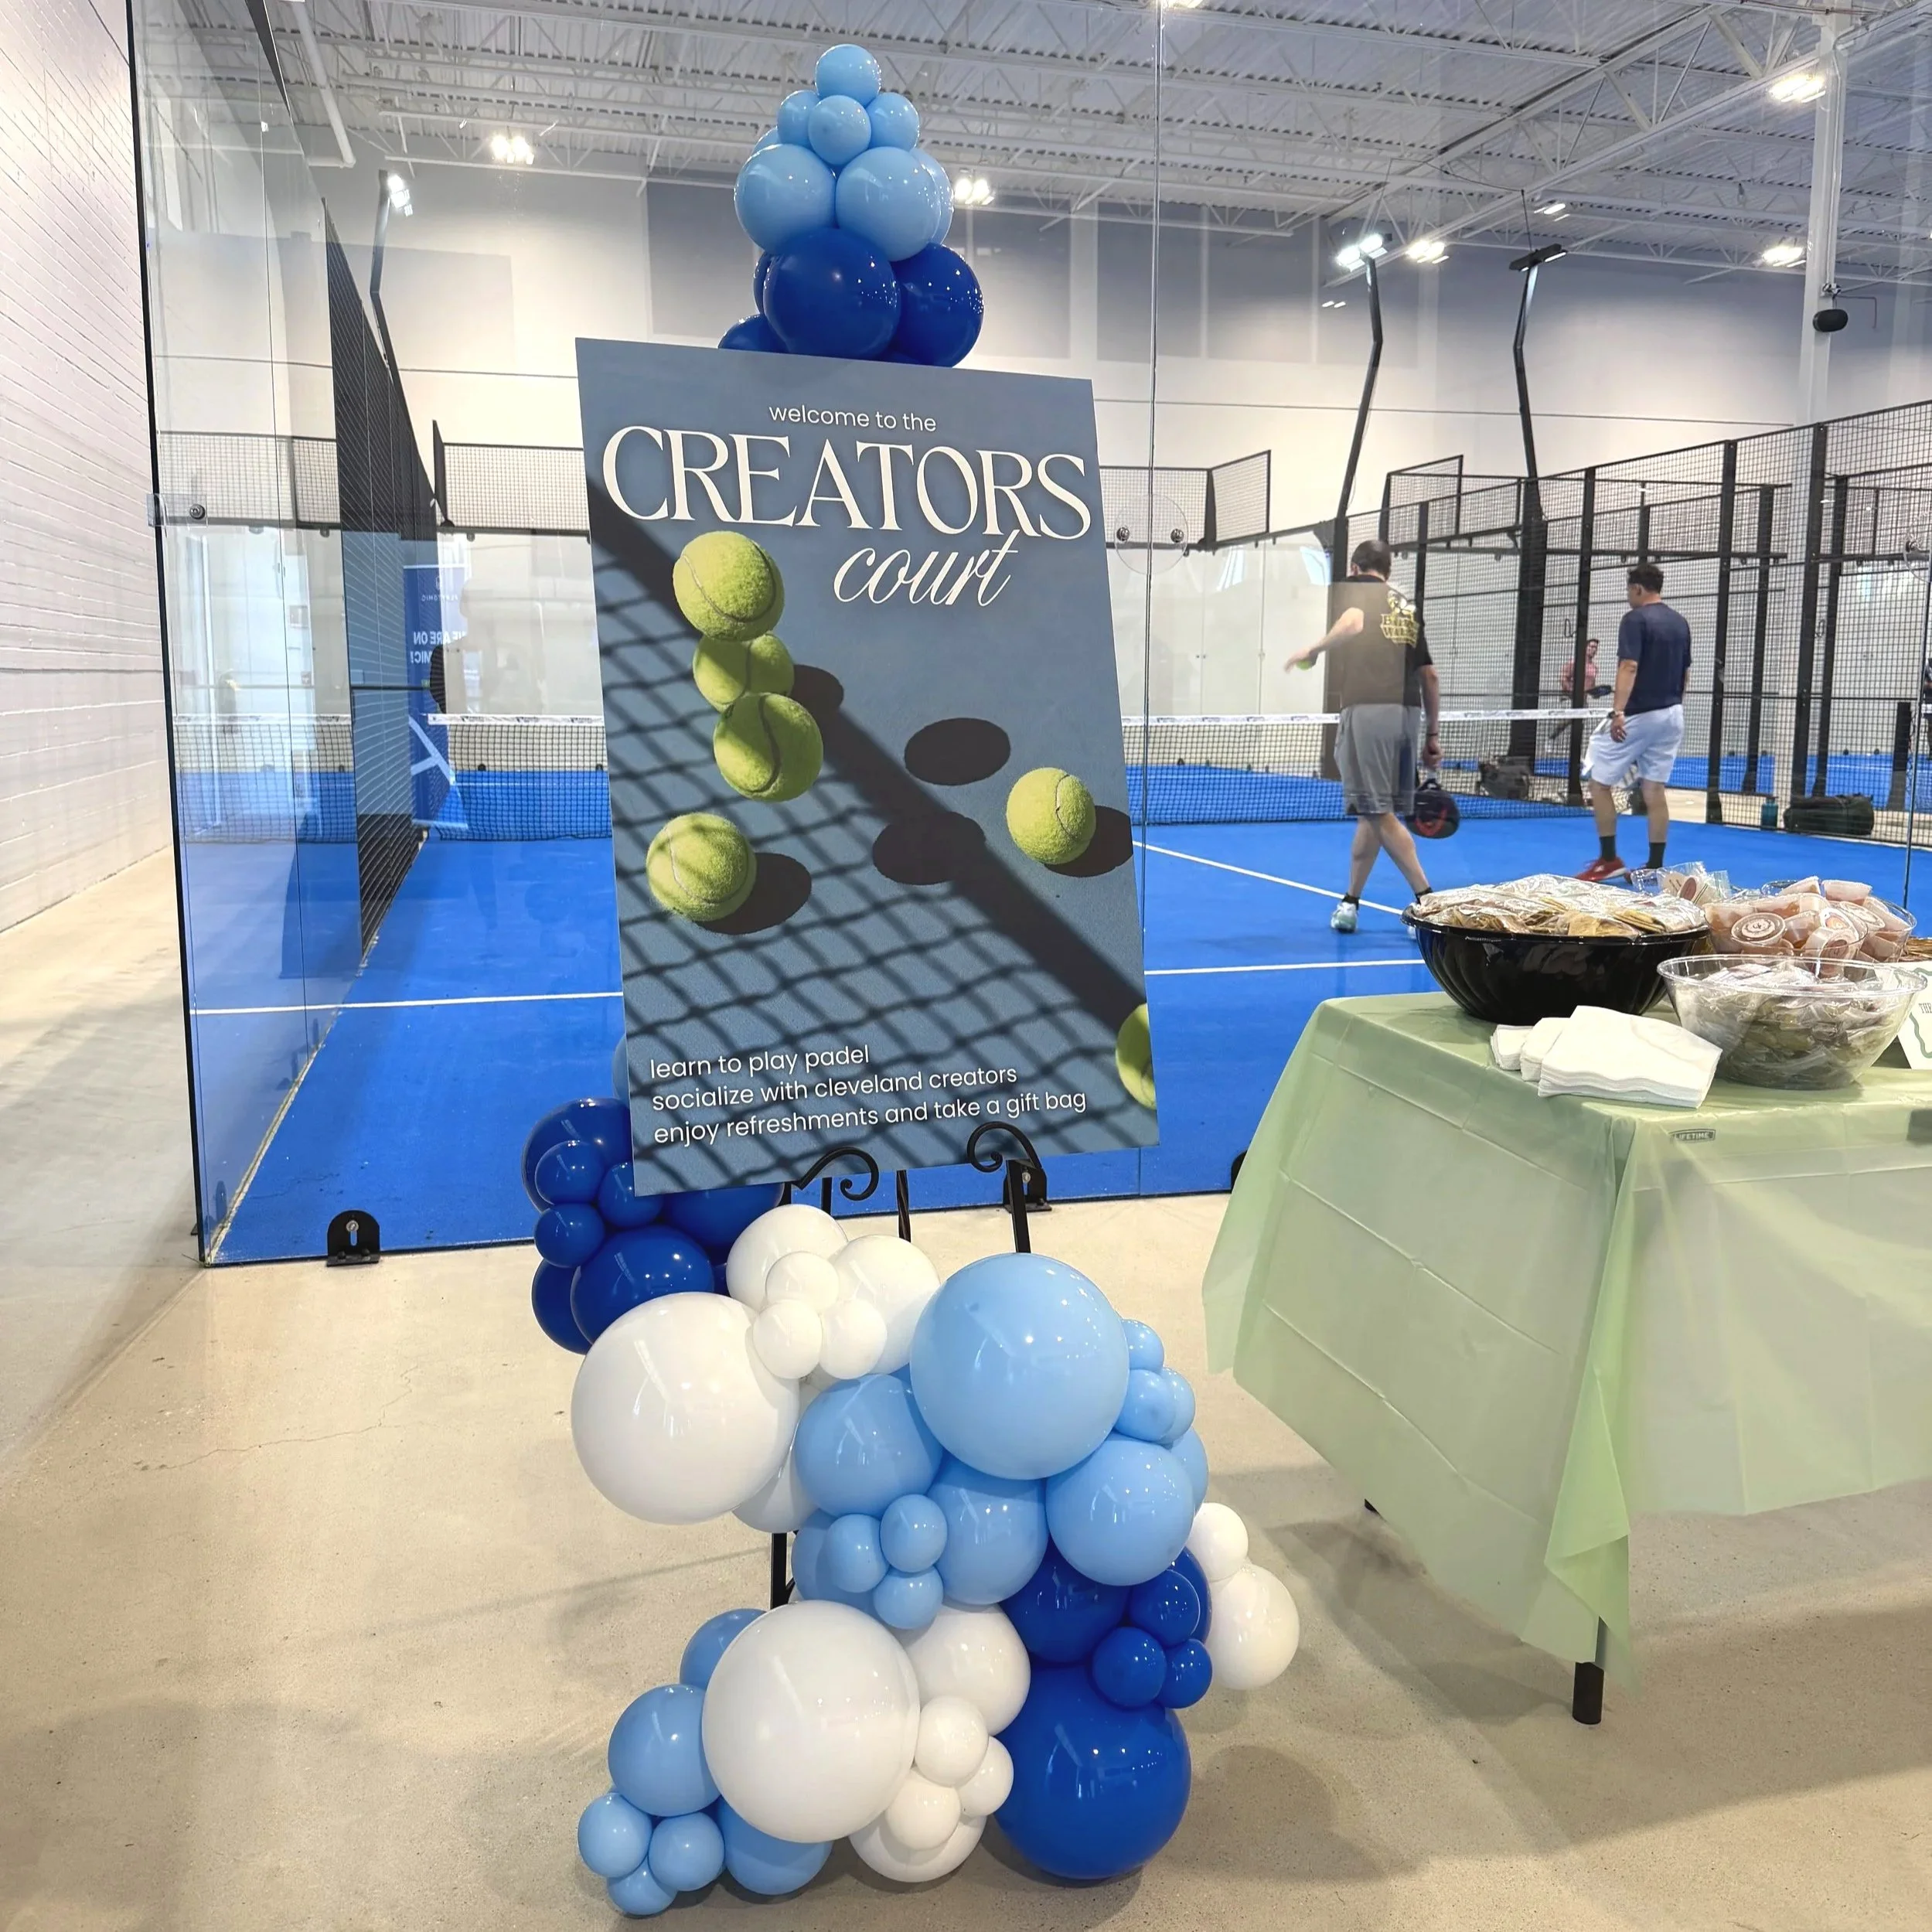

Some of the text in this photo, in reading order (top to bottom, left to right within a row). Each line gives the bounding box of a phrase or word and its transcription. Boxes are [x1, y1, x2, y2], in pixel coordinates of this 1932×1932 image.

[768, 404, 936, 432] welcome to the
[602, 425, 1091, 540] CREATORS
[833, 529, 1021, 607] court
[650, 1044, 869, 1078] learn to play padel
[653, 1068, 1017, 1111] socialize with cleveland creators
[654, 1088, 1086, 1147] enjoy refreshments and take a gift bag
